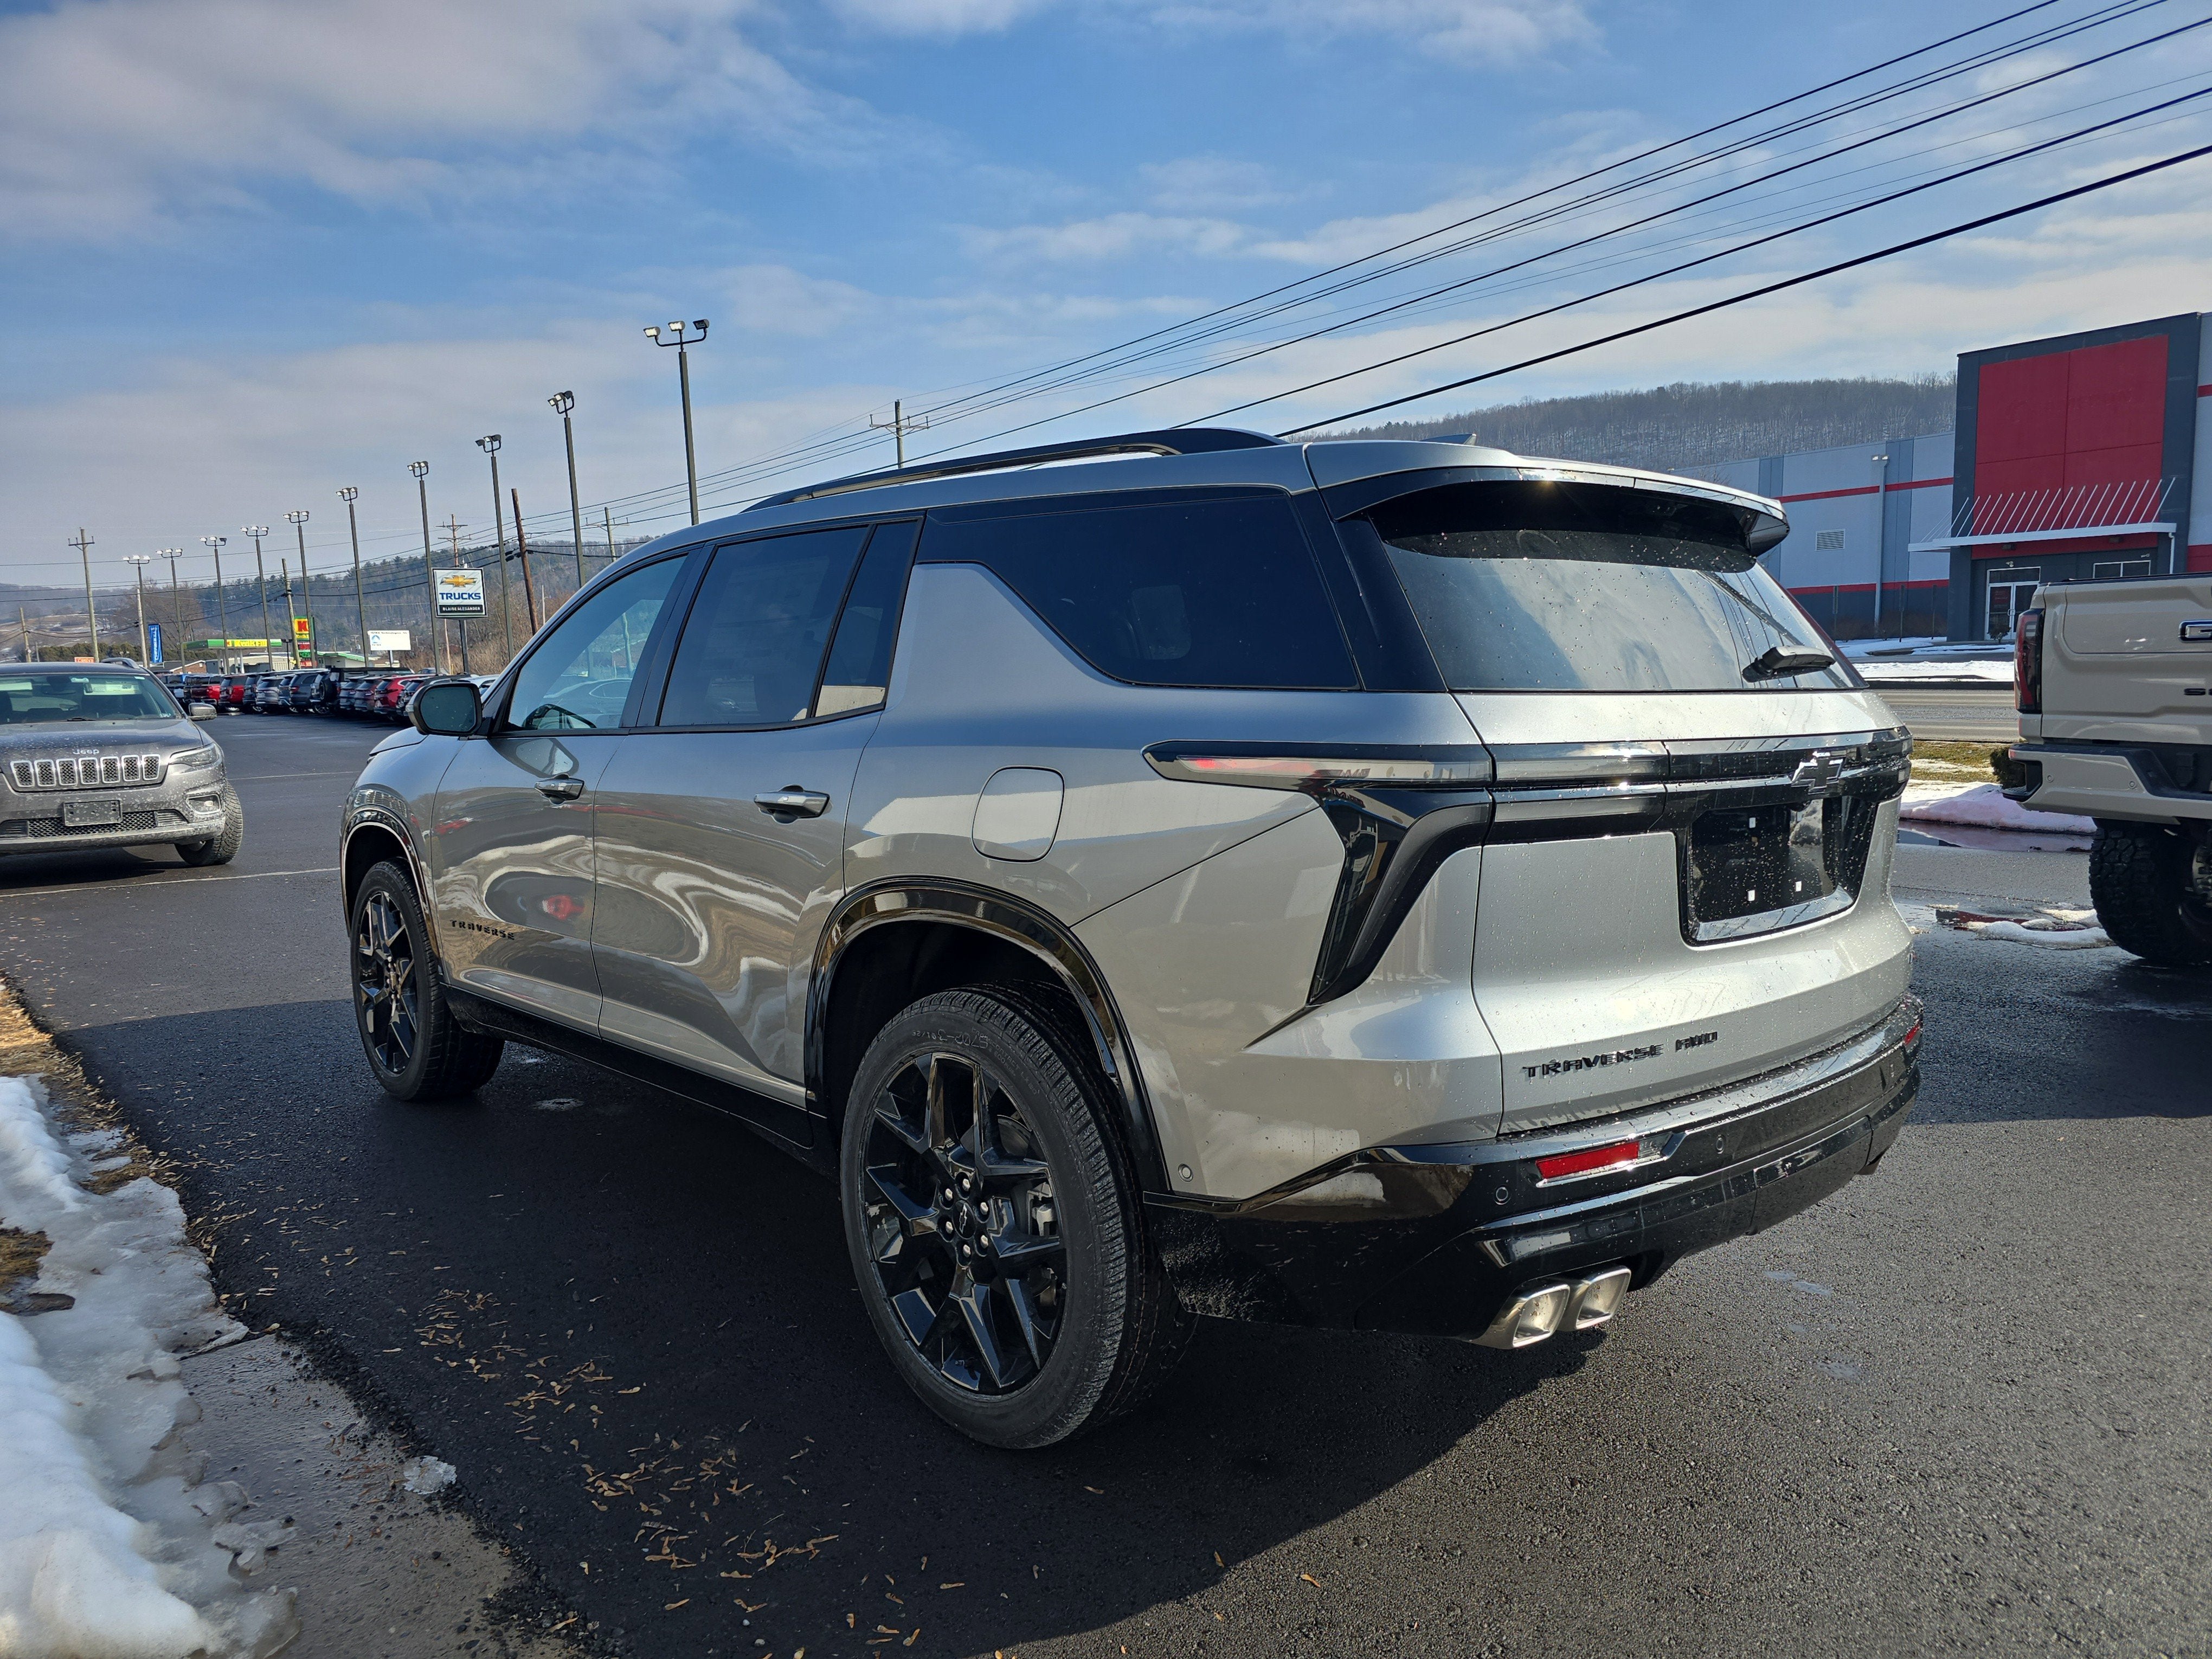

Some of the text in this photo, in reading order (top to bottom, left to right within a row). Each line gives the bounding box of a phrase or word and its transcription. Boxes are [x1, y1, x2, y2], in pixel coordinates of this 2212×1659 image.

[439, 592, 481, 600] TRUCKS
[297, 621, 308, 632] K
[449, 920, 515, 940] TRAVERSE
[1522, 1031, 1718, 1077] TRAVERSE AWD
